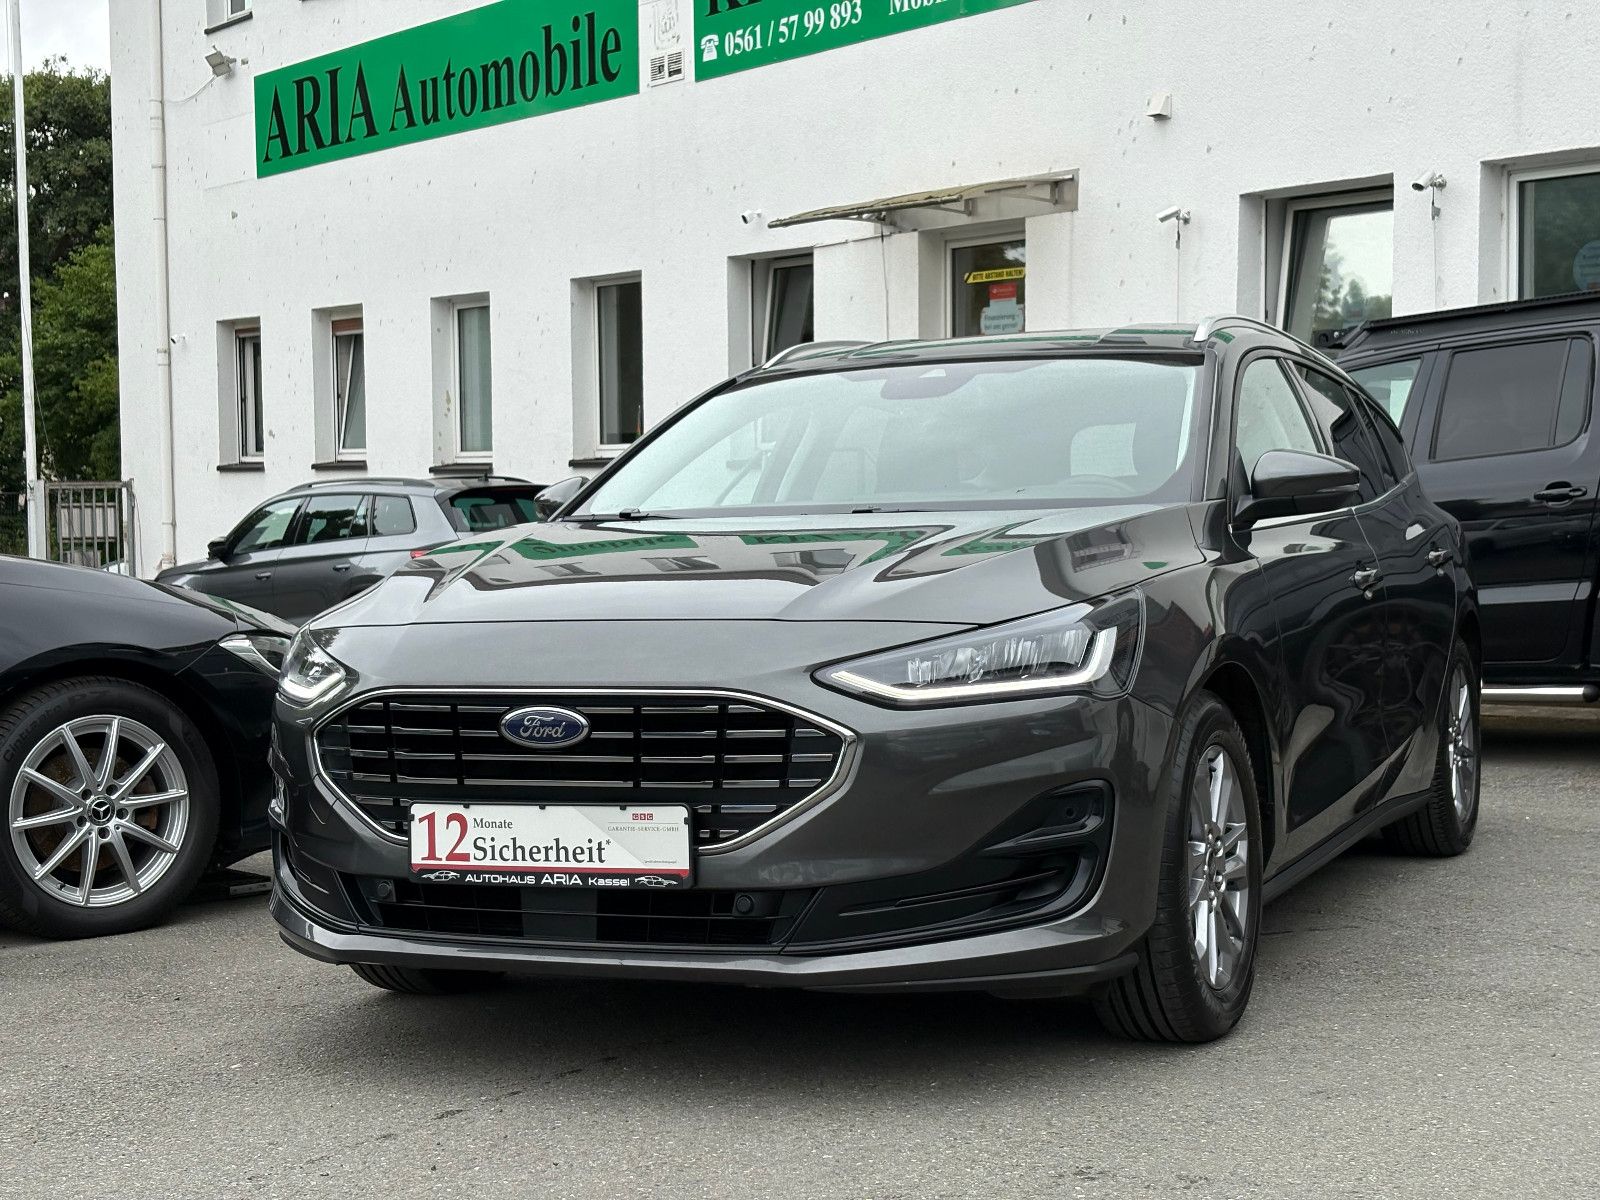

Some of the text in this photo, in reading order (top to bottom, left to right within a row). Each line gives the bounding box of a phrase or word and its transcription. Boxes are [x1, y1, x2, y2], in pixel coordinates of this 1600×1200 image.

[724, 24, 763, 57] 0561
[767, 20, 775, 47] /
[778, 14, 799, 44] 57
[804, 8, 825, 38] 99
[829, 0, 863, 30] 893
[263, 12, 623, 163] ARIA Automobile
[520, 715, 566, 738] Ford
[418, 811, 513, 863] 12 Monate
[465, 873, 630, 887] AUTOHAUS ARIA Kassel
